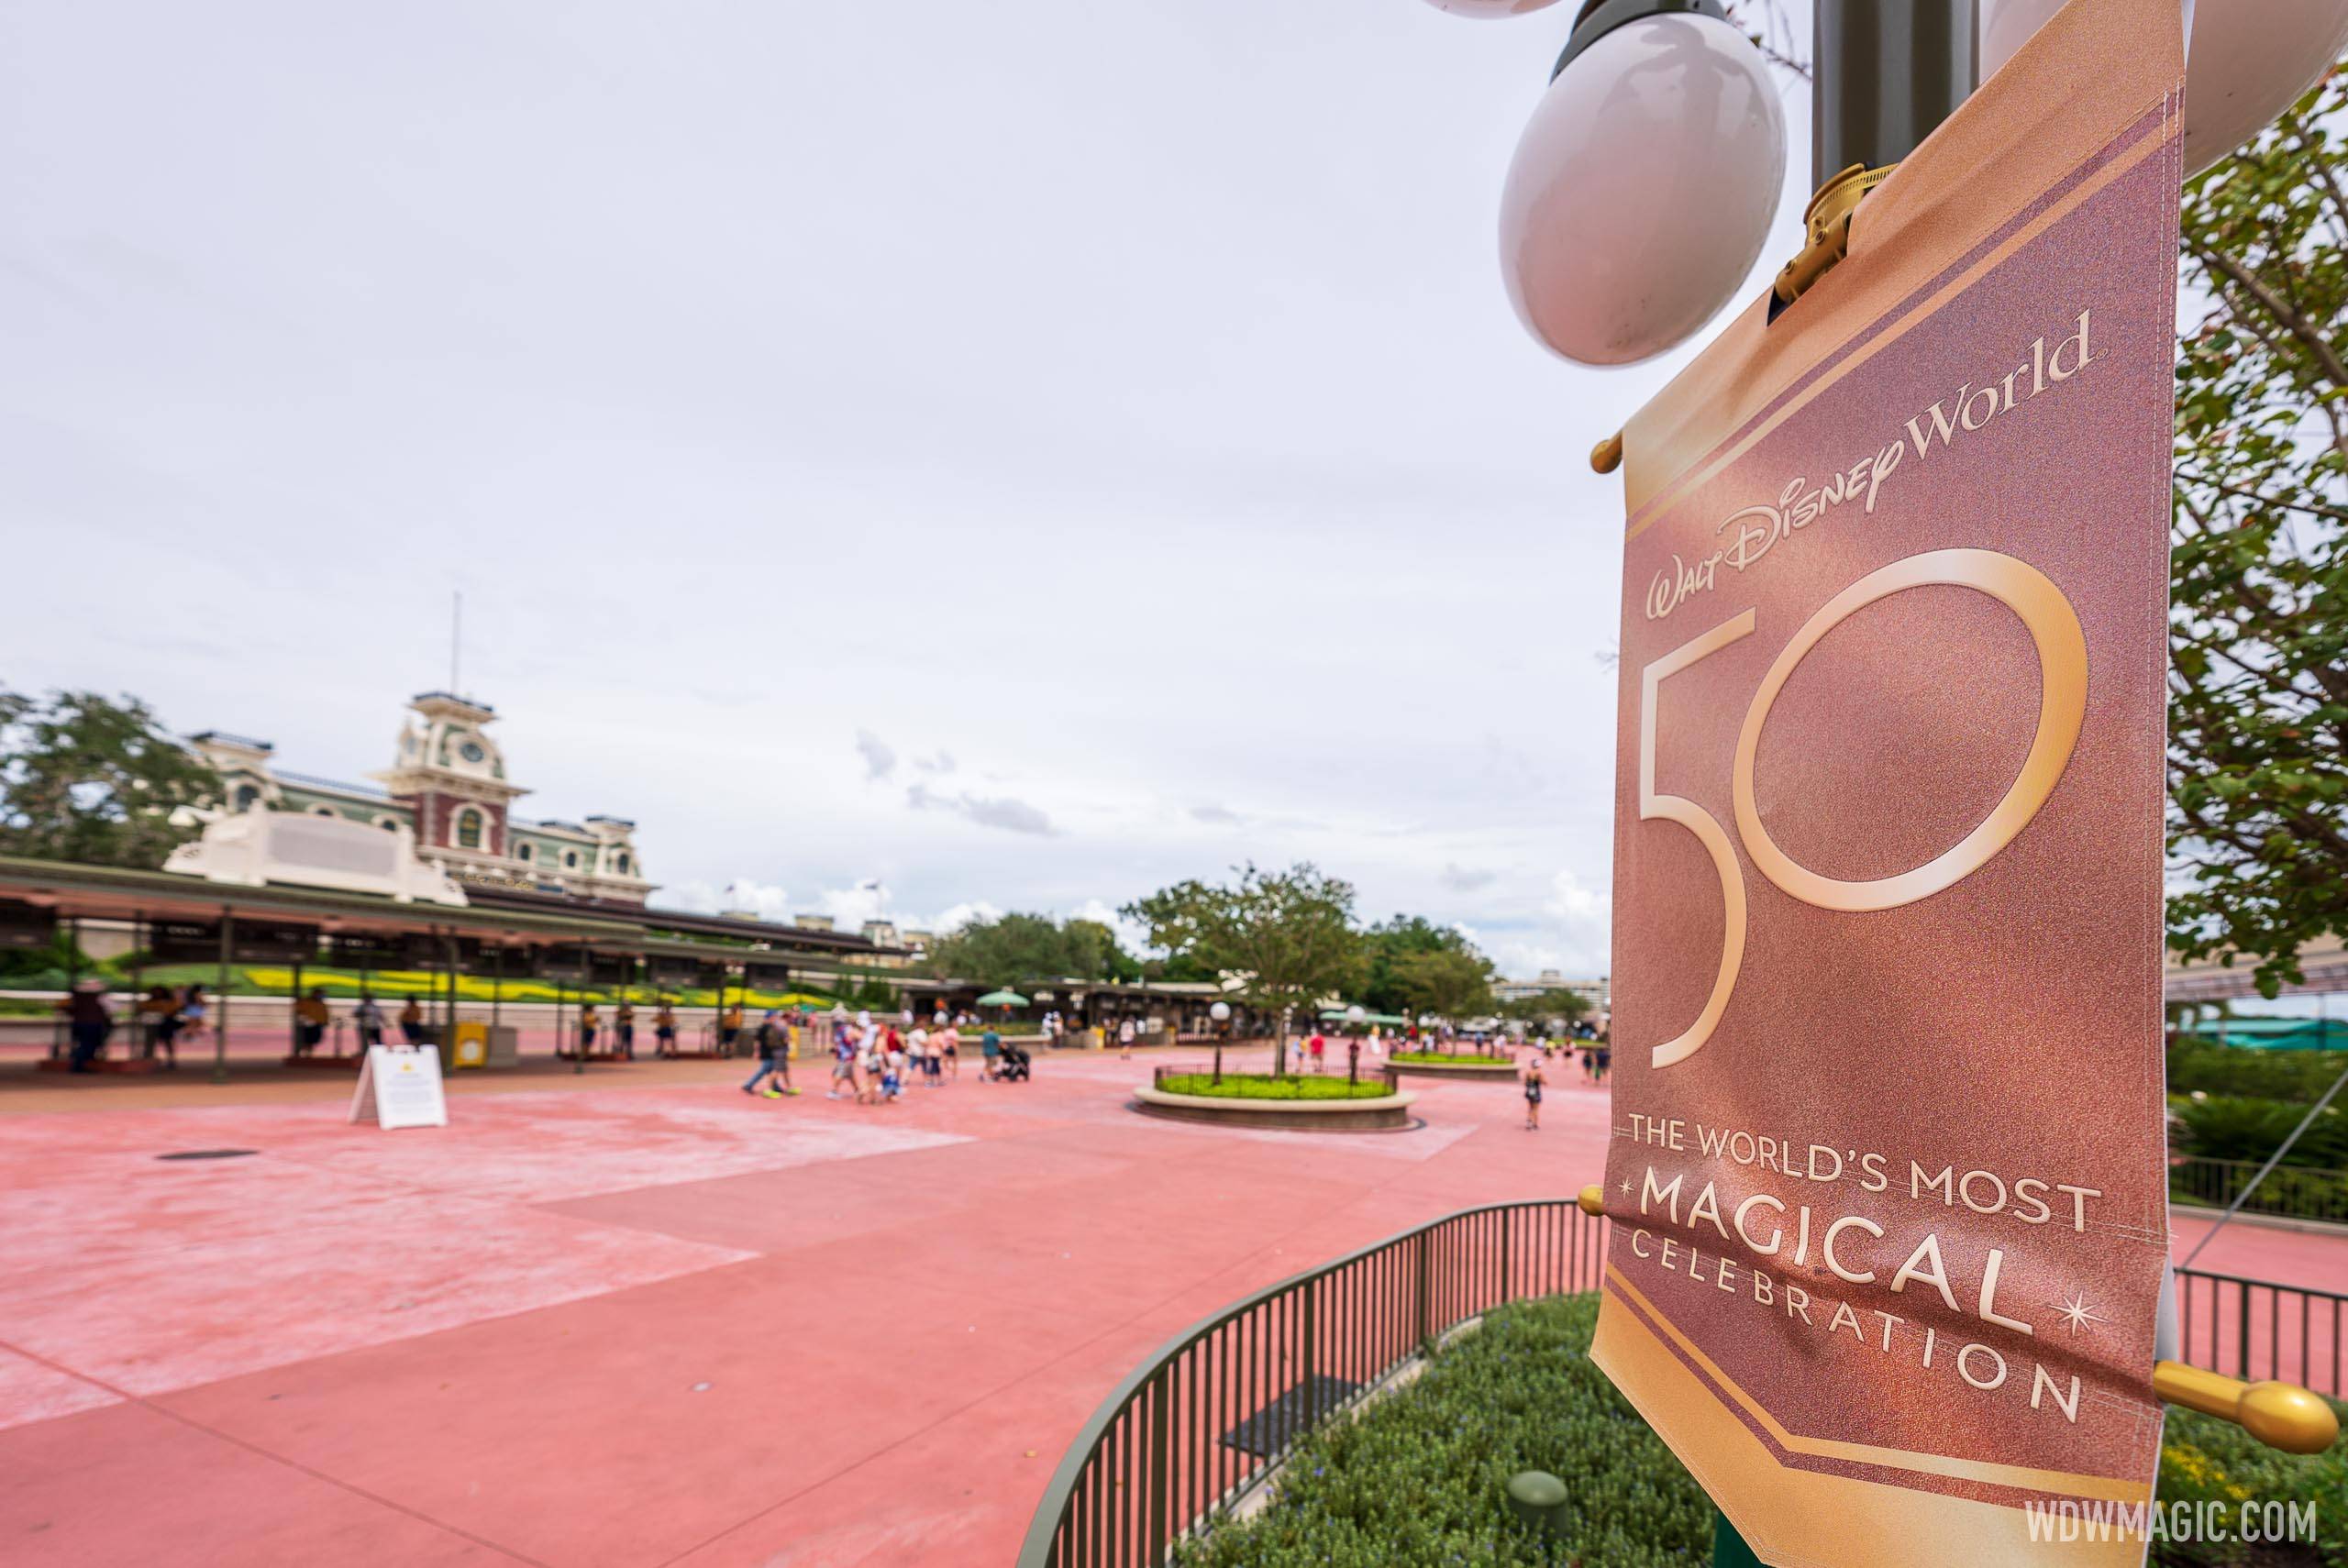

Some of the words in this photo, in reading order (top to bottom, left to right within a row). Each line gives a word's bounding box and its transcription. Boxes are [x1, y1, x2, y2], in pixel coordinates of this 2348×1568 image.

[1640, 547, 2088, 1069] 50
[1628, 1112, 1685, 1152] THE
[1911, 1159, 2102, 1232] MOST
[1640, 1165, 2034, 1335] MAGICAL
[1631, 1228, 2081, 1425] CELEBRATION
